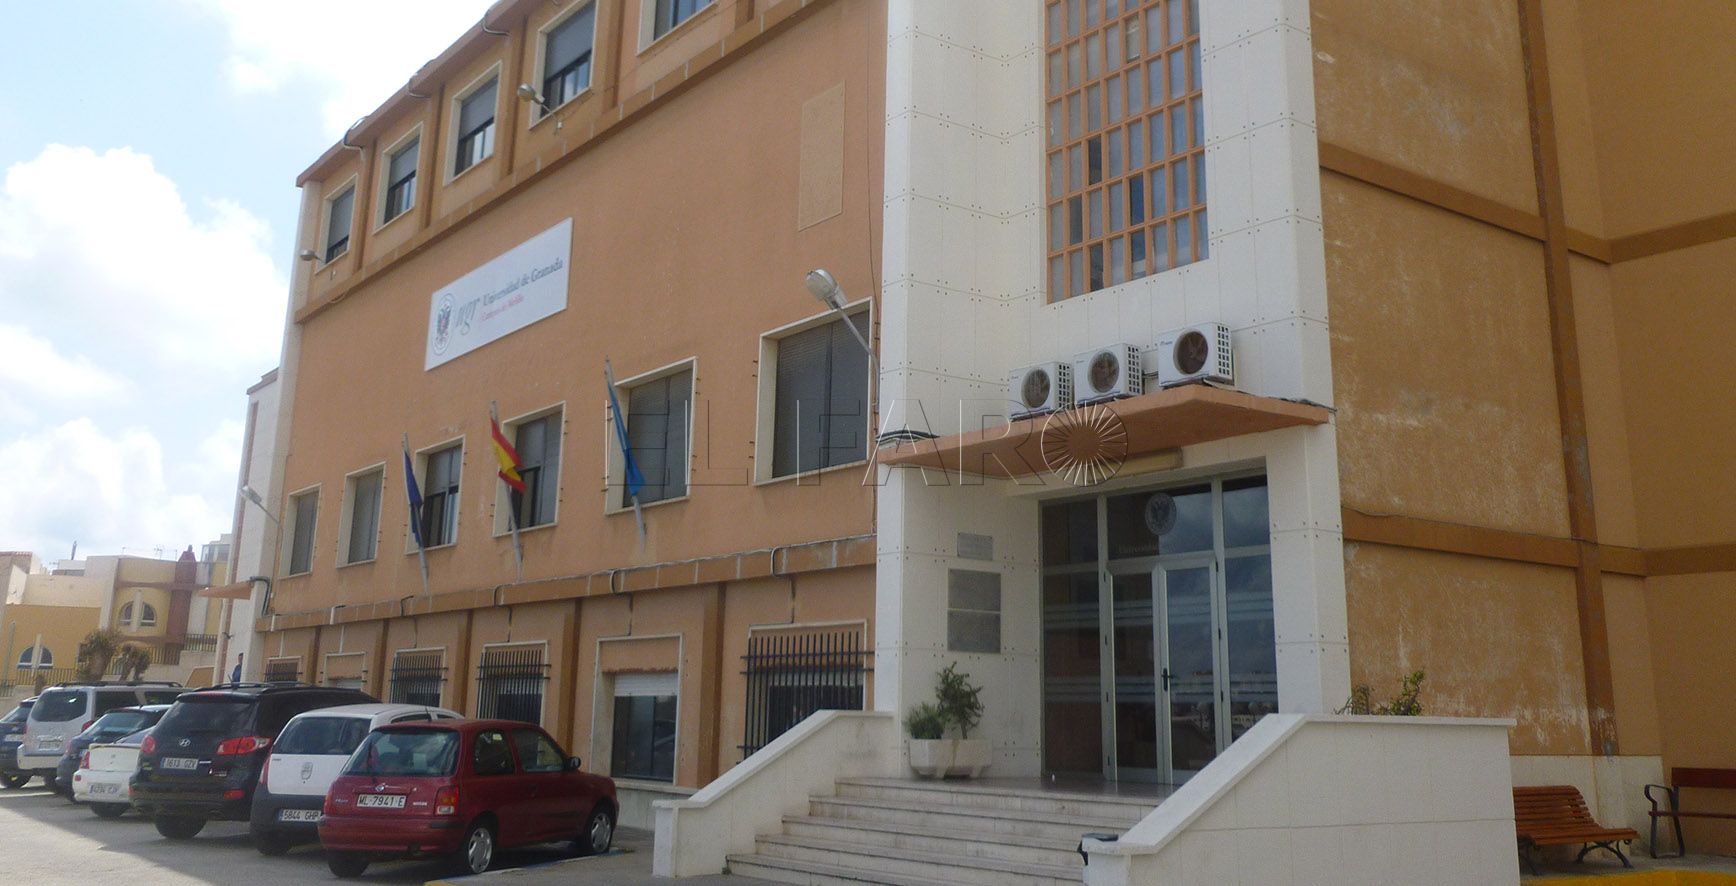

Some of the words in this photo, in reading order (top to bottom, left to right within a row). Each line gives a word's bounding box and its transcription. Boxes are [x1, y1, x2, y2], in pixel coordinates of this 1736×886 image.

[483, 278, 520, 305] Universidad
[521, 274, 530, 287] de
[531, 257, 563, 282] Granada
